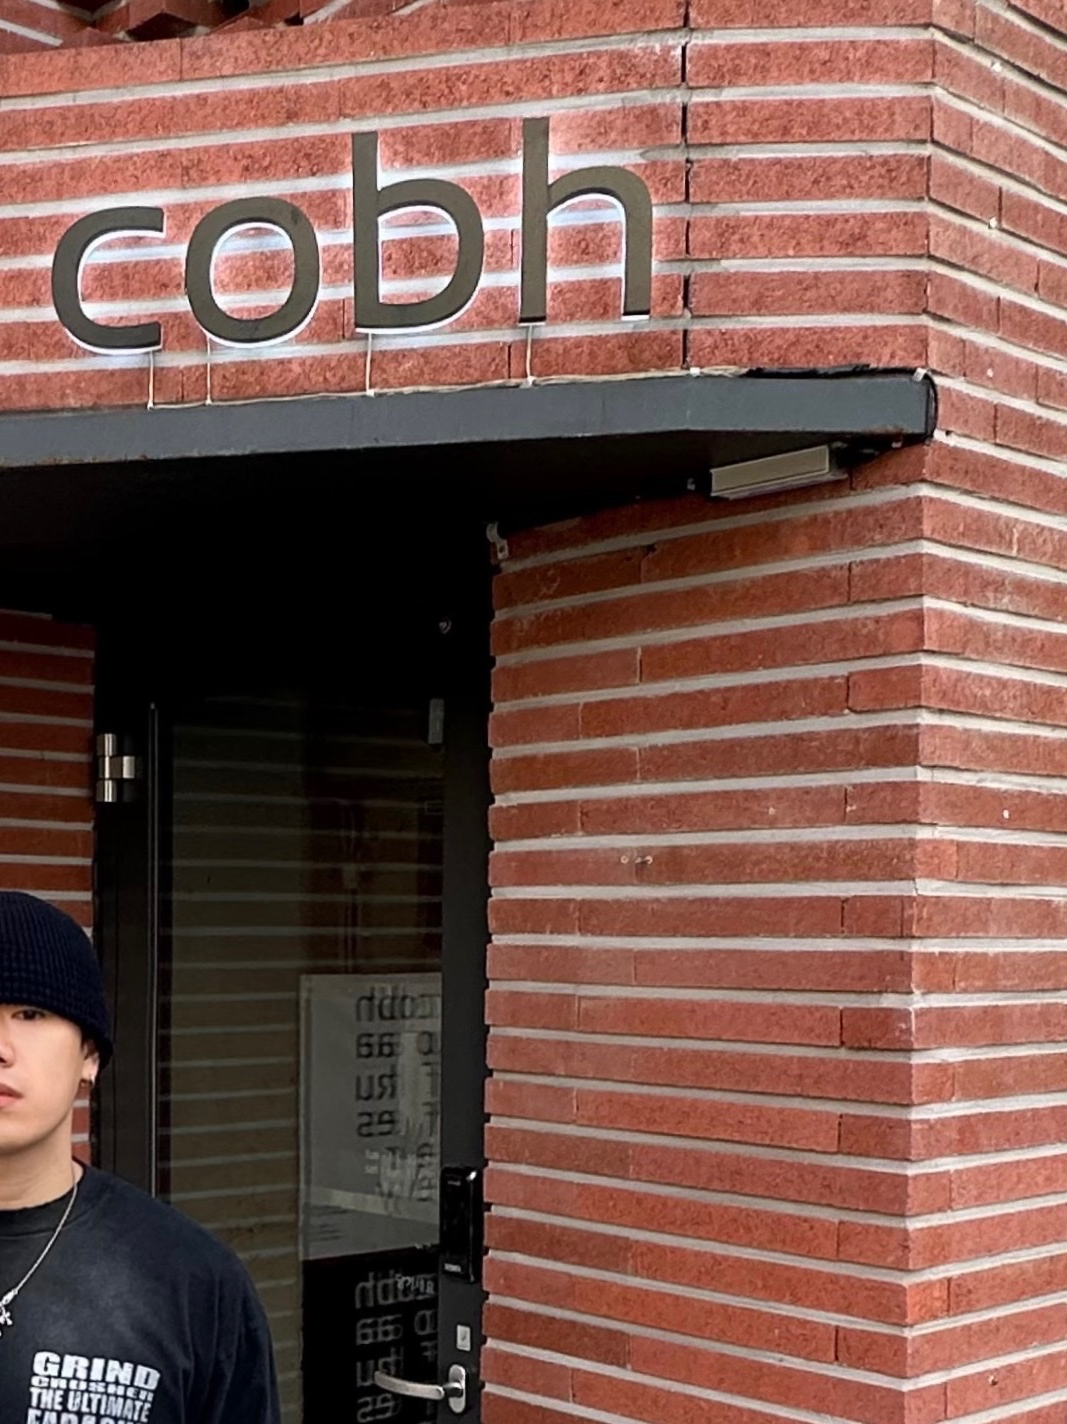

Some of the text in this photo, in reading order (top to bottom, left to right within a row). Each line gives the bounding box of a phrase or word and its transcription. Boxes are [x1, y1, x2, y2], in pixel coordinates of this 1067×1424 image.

[51, 117, 653, 354] cobh
[30, 1375, 154, 1402] CRUSHER
[32, 1351, 161, 1391] GRIND
[29, 1387, 152, 1423] THE ULTIMATE
